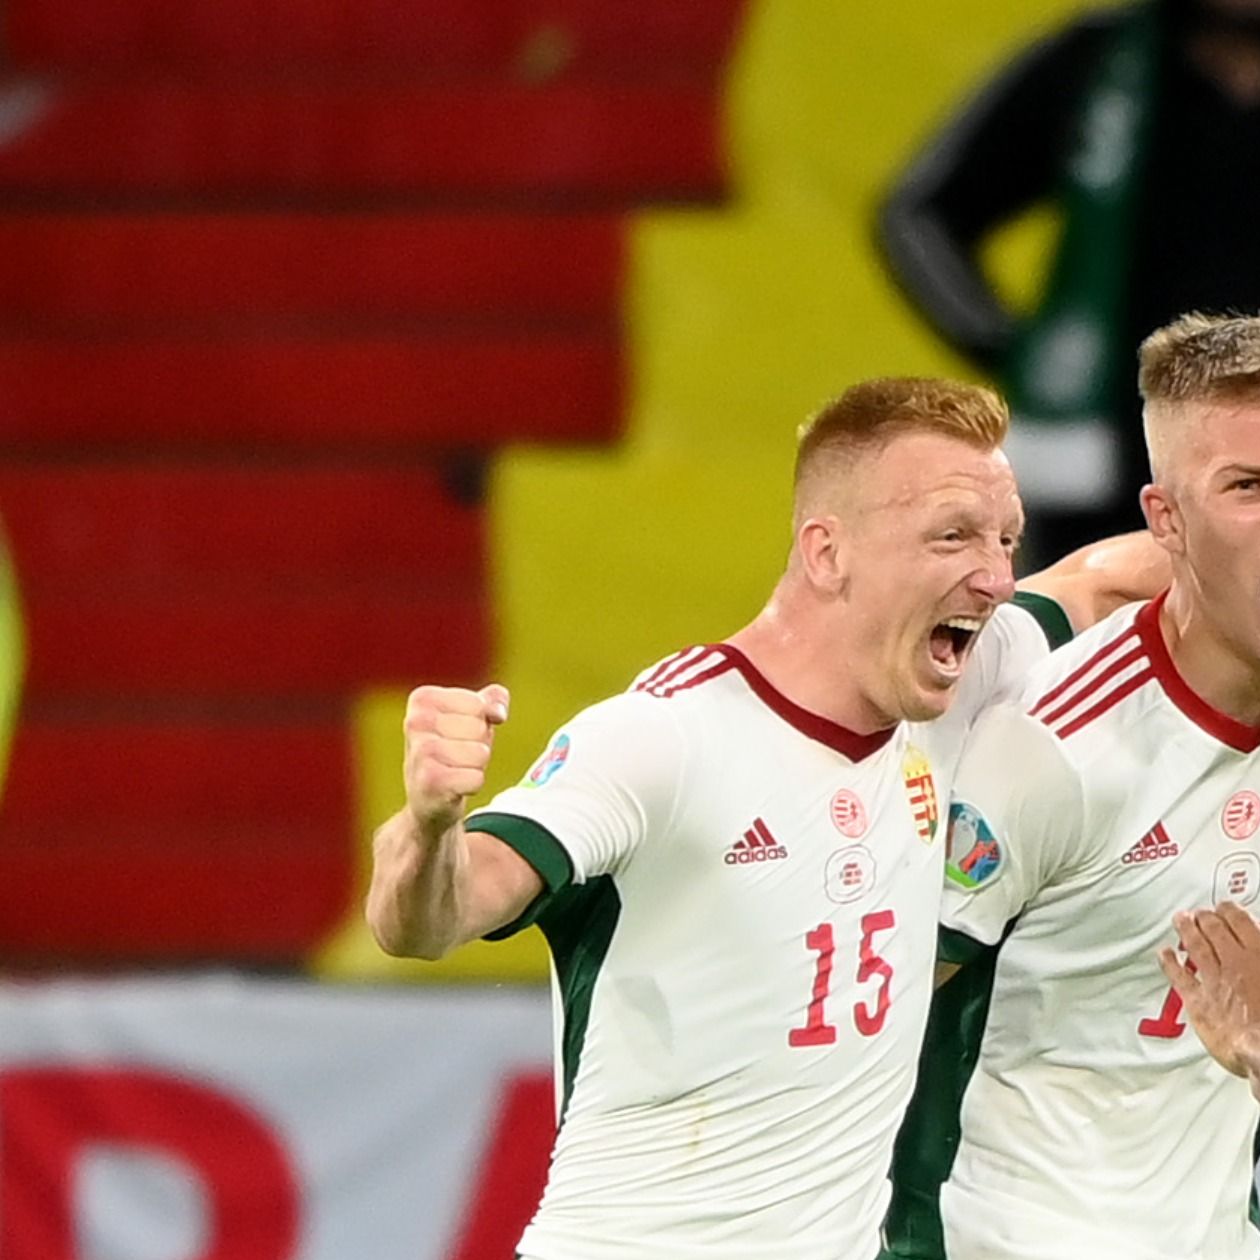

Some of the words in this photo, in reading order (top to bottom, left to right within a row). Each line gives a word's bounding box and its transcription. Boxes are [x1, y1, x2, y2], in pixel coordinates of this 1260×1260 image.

[724, 845, 788, 865] adidas
[1121, 843, 1178, 865] adidas
[789, 910, 895, 1047] 15
